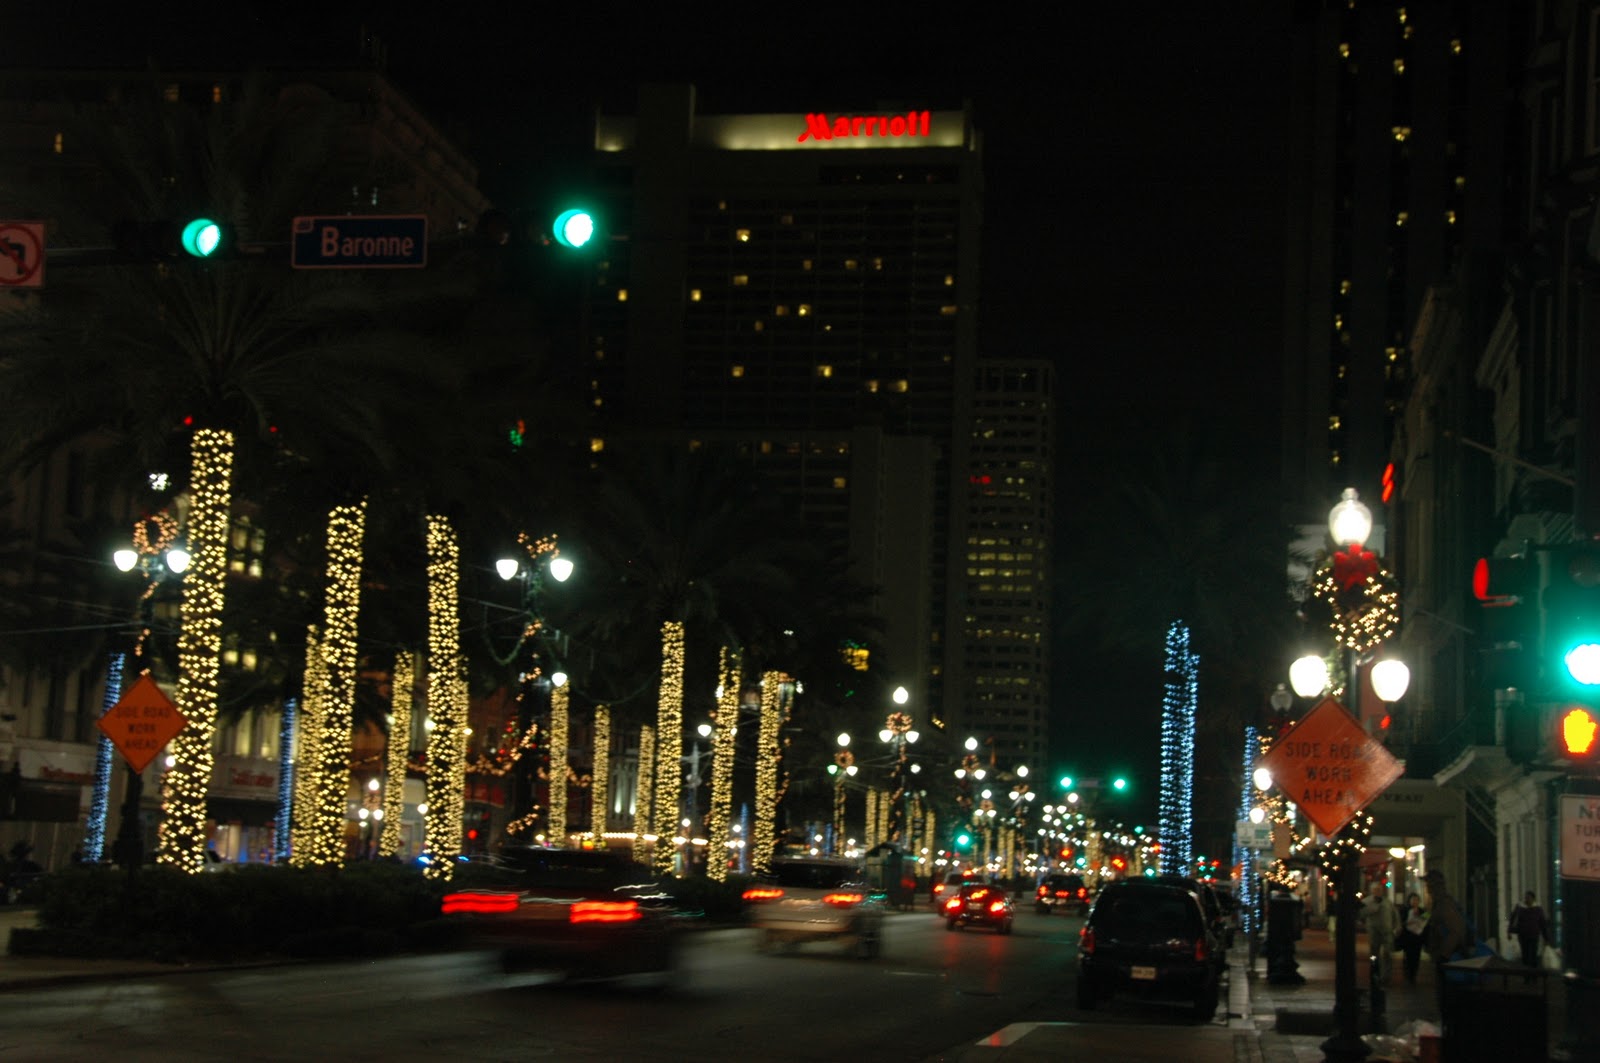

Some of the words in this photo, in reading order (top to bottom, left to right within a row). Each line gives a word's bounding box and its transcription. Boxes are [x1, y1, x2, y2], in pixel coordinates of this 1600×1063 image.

[320, 225, 415, 257] Baronne
[1286, 742, 1321, 758] SIDE
[1306, 766, 1352, 782] WORK
